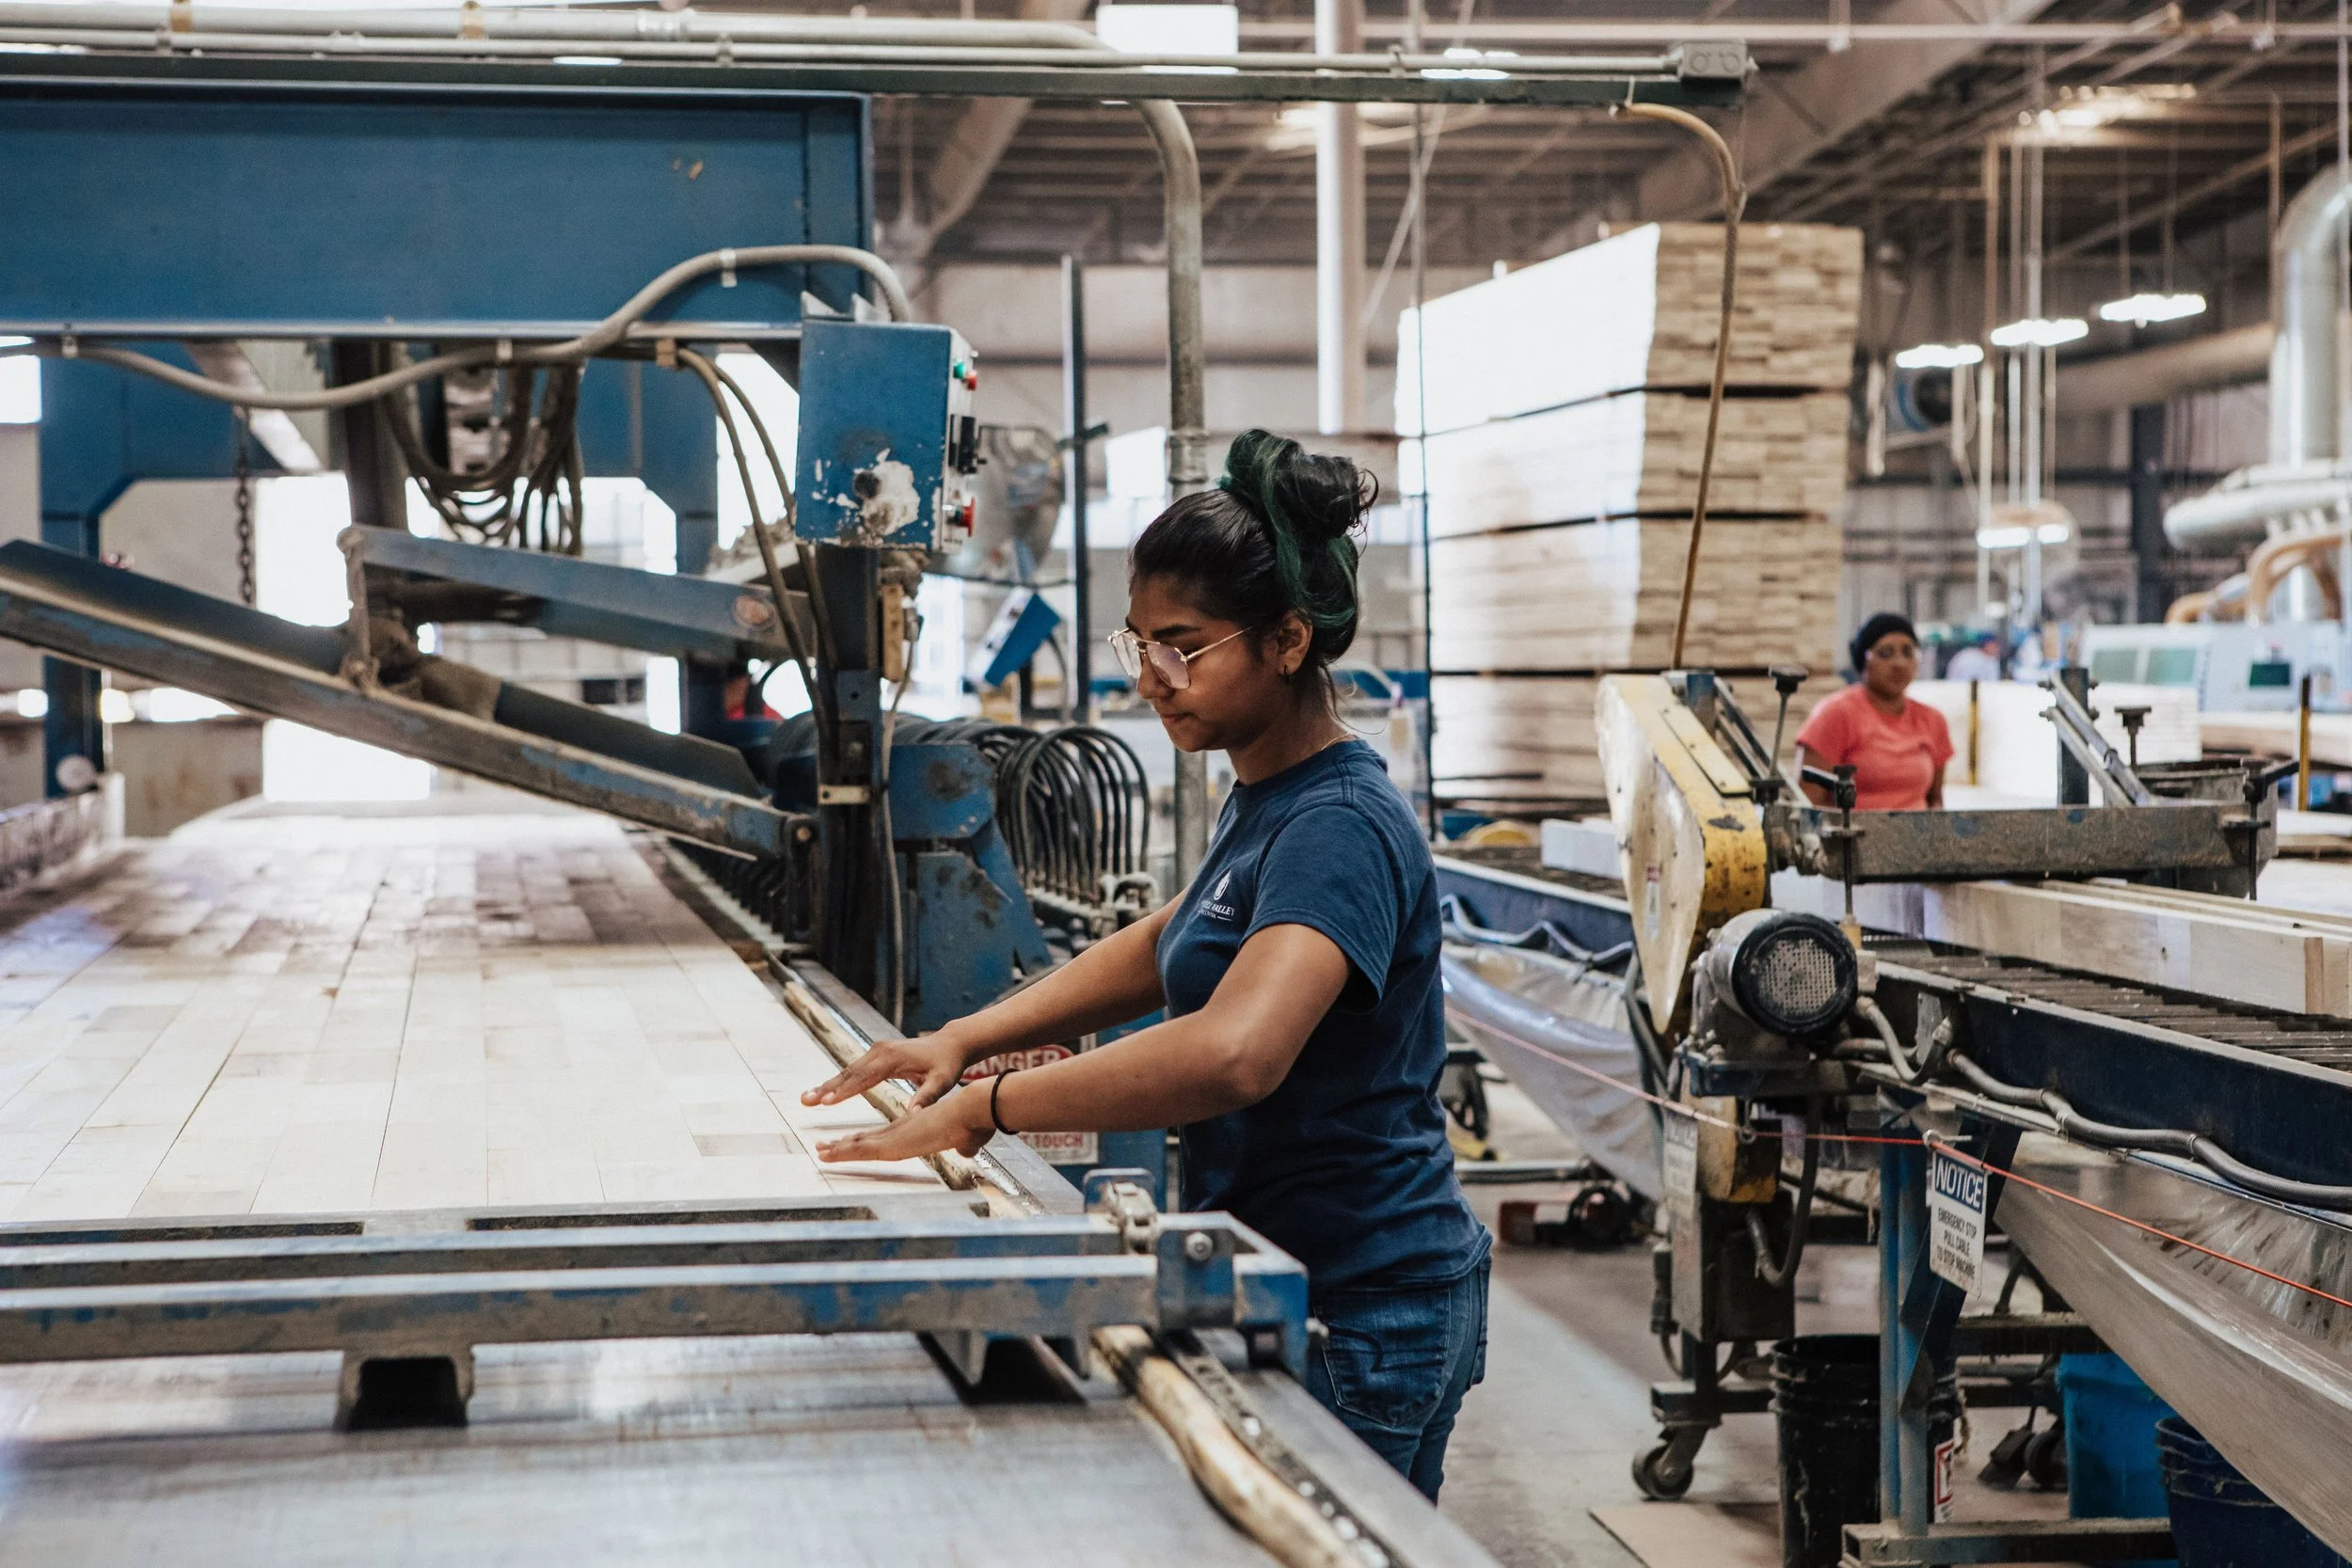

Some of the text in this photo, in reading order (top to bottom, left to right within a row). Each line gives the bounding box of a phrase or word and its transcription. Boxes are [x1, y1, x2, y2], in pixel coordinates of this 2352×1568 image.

[1212, 903, 1235, 916] VALLEY
[969, 1049, 1062, 1076] ANGER
[1034, 1133, 1084, 1148] TOUCH
[1935, 1157, 1984, 1209] NOTICE
